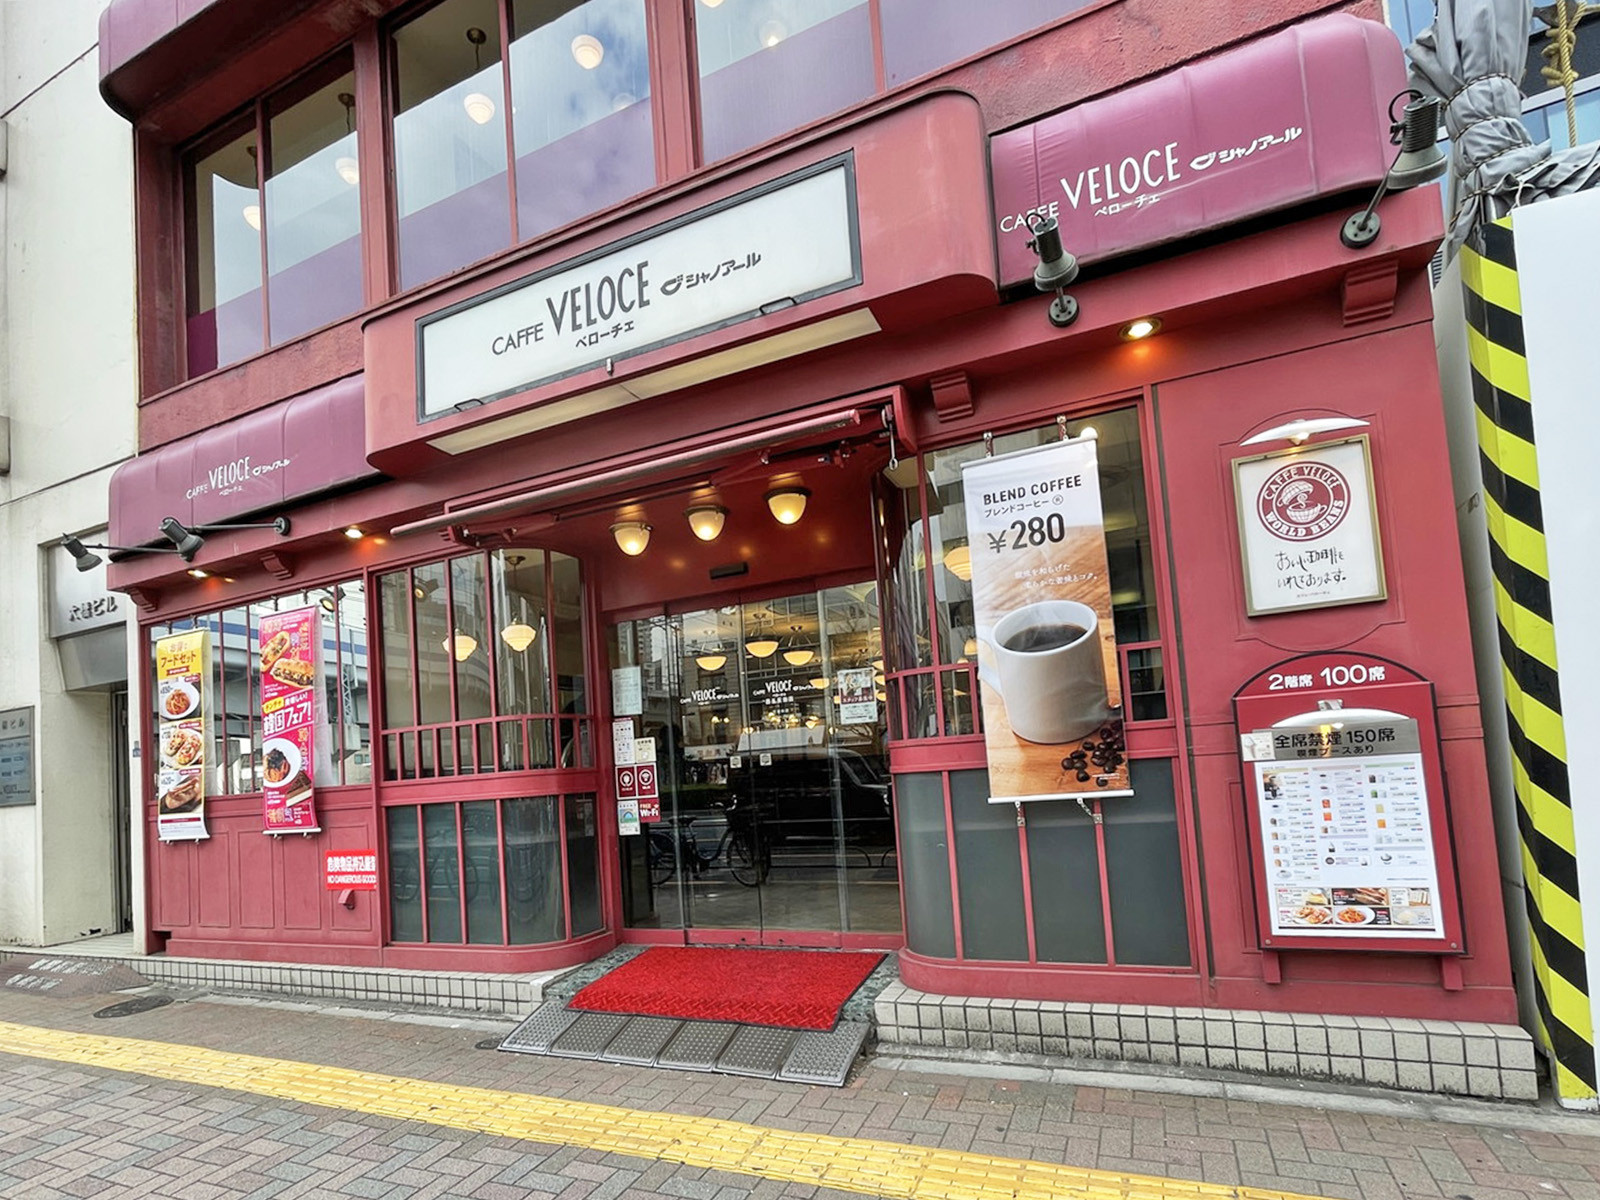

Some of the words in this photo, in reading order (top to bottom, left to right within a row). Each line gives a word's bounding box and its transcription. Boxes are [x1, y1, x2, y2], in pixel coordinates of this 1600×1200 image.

[1219, 127, 1303, 164] シャノアール
[1060, 142, 1181, 210] VELOCE
[1094, 194, 1161, 217] ベローチェ
[685, 252, 762, 290] シャノアール
[492, 323, 544, 356] CAFFE
[546, 260, 650, 335] VELOCE
[575, 320, 635, 348] ベローチェ
[208, 456, 250, 490] VELOCE
[1264, 466, 1299, 500] CAFFE
[1302, 465, 1341, 489] VELOCE
[983, 486, 1026, 505] BLEND
[1031, 475, 1082, 496] COFFEE
[984, 499, 1049, 518] ブレンドコーヒー
[1264, 511, 1307, 537] WORLD
[1311, 499, 1344, 535] BEANS
[987, 512, 1065, 554] ¥280
[161, 650, 196, 668] フードセット
[765, 680, 793, 694] VELOCE
[1268, 673, 1313, 691] 2階席
[1320, 664, 1386, 687] 100席
[691, 688, 717, 701] VELOCE
[263, 701, 312, 736] 韓国フェア!
[1275, 731, 1342, 750] 全席禁煙
[1346, 727, 1396, 744] 150席
[639, 808, 659, 818] Wi-Fi
